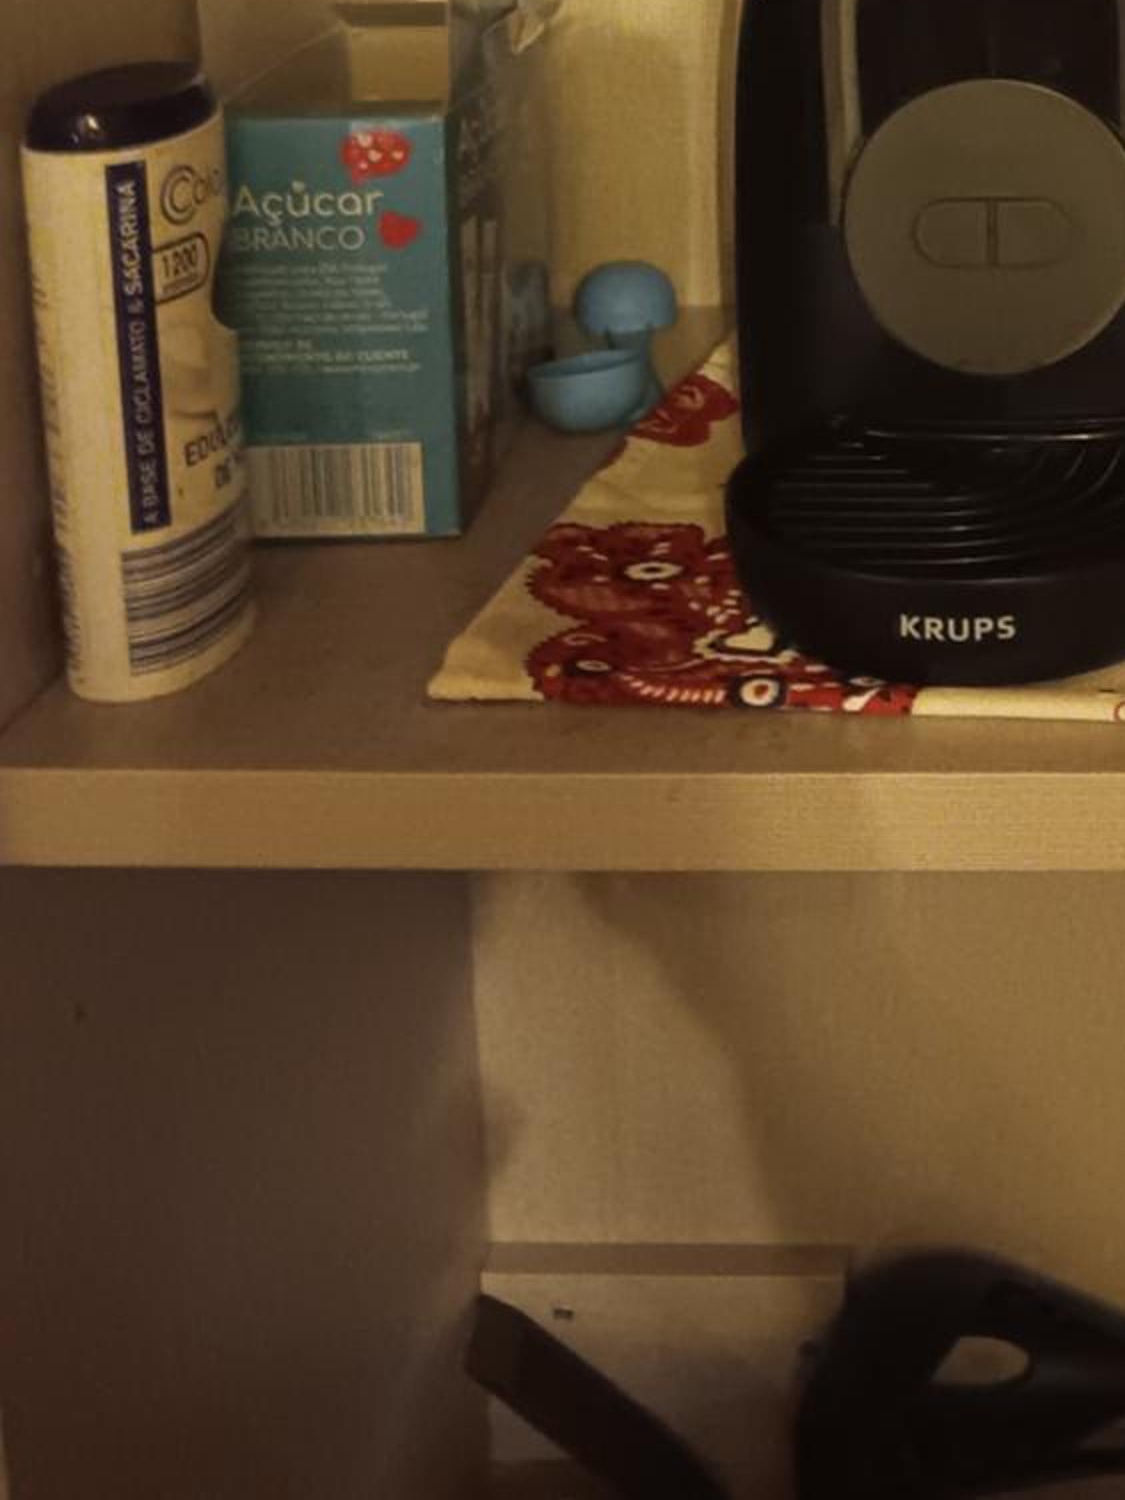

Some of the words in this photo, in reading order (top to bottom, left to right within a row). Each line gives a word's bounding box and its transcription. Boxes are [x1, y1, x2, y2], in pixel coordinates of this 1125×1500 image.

[234, 180, 385, 227] Açúcar
[116, 179, 144, 296] SACARINA
[233, 226, 366, 251] BRANCO
[136, 427, 156, 456] DE
[138, 459, 159, 508] BASE
[900, 613, 1017, 642] KRUPS
